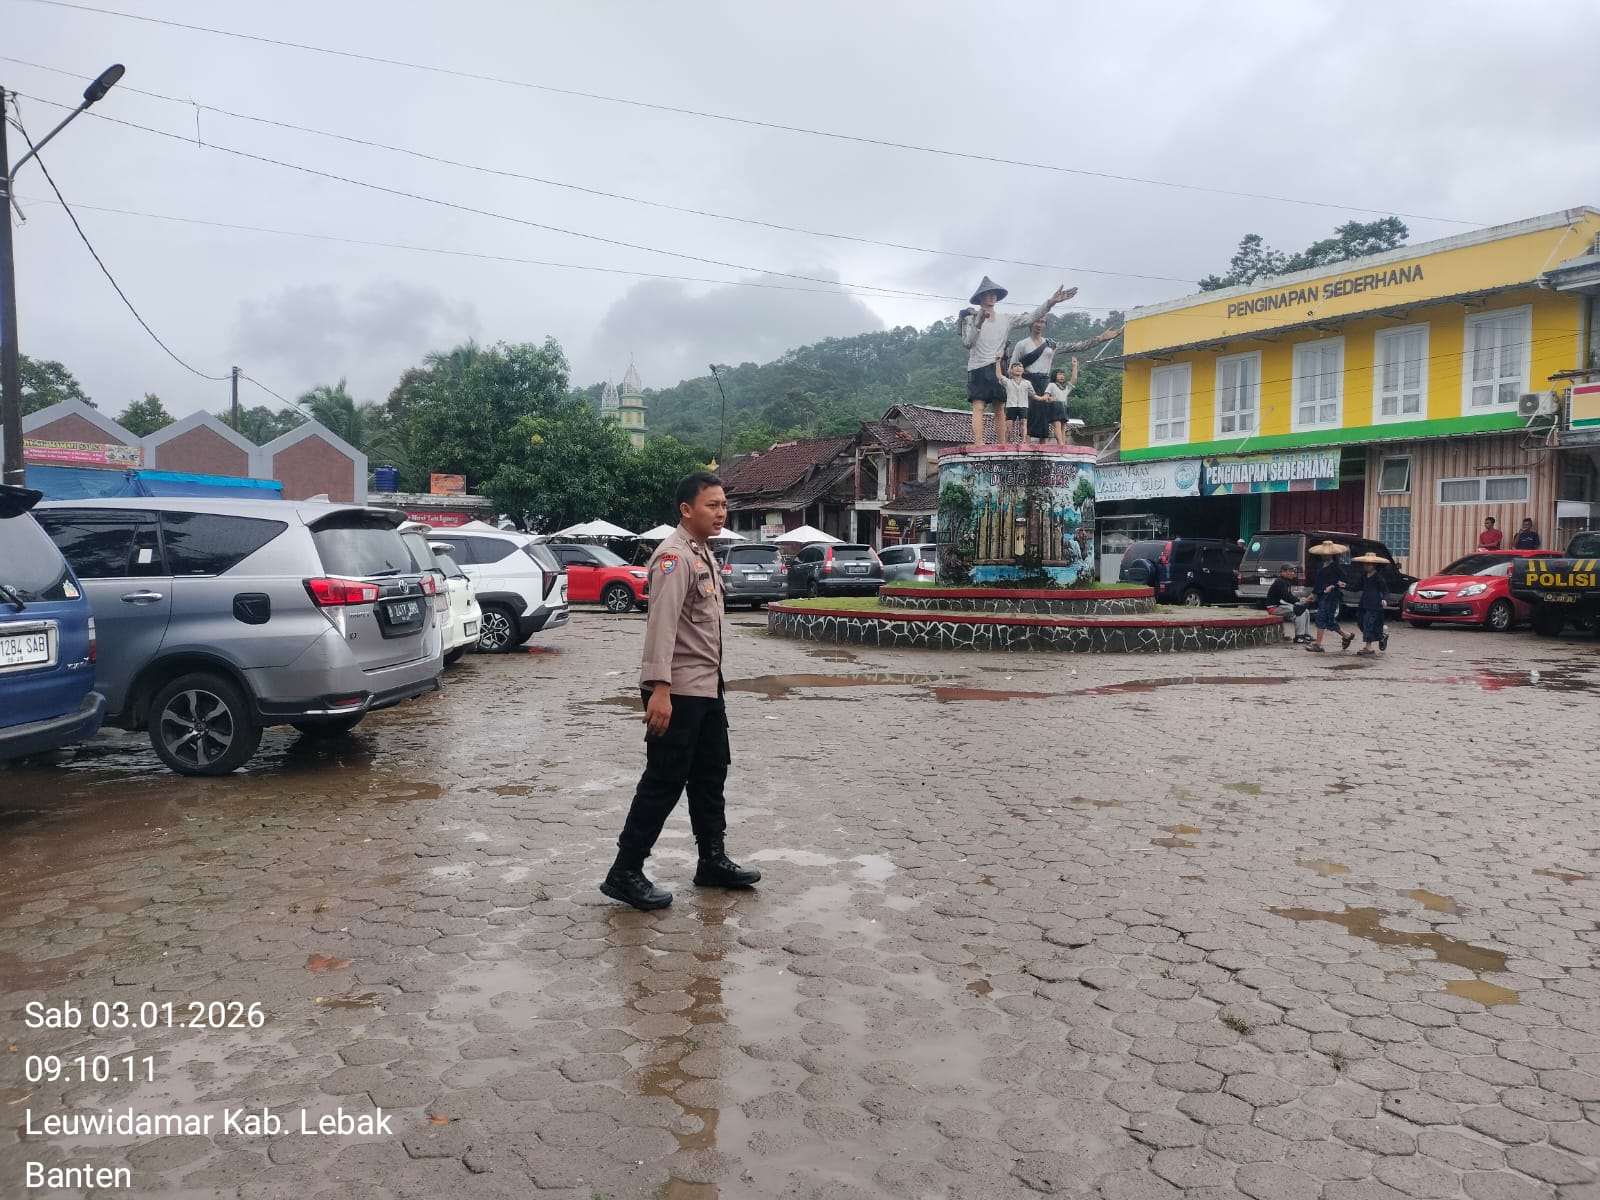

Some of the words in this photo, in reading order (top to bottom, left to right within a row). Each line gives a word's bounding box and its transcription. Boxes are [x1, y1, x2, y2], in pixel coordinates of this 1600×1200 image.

[1228, 286, 1319, 318] PENGINAPAN
[1322, 264, 1424, 300] SEDERHANA
[1206, 463, 1269, 485] PENGINAPAN
[1270, 458, 1335, 481] SEDERHANA
[1526, 573, 1596, 587] POLISI
[0, 639, 22, 657] 1284
[26, 636, 45, 654] SAB
